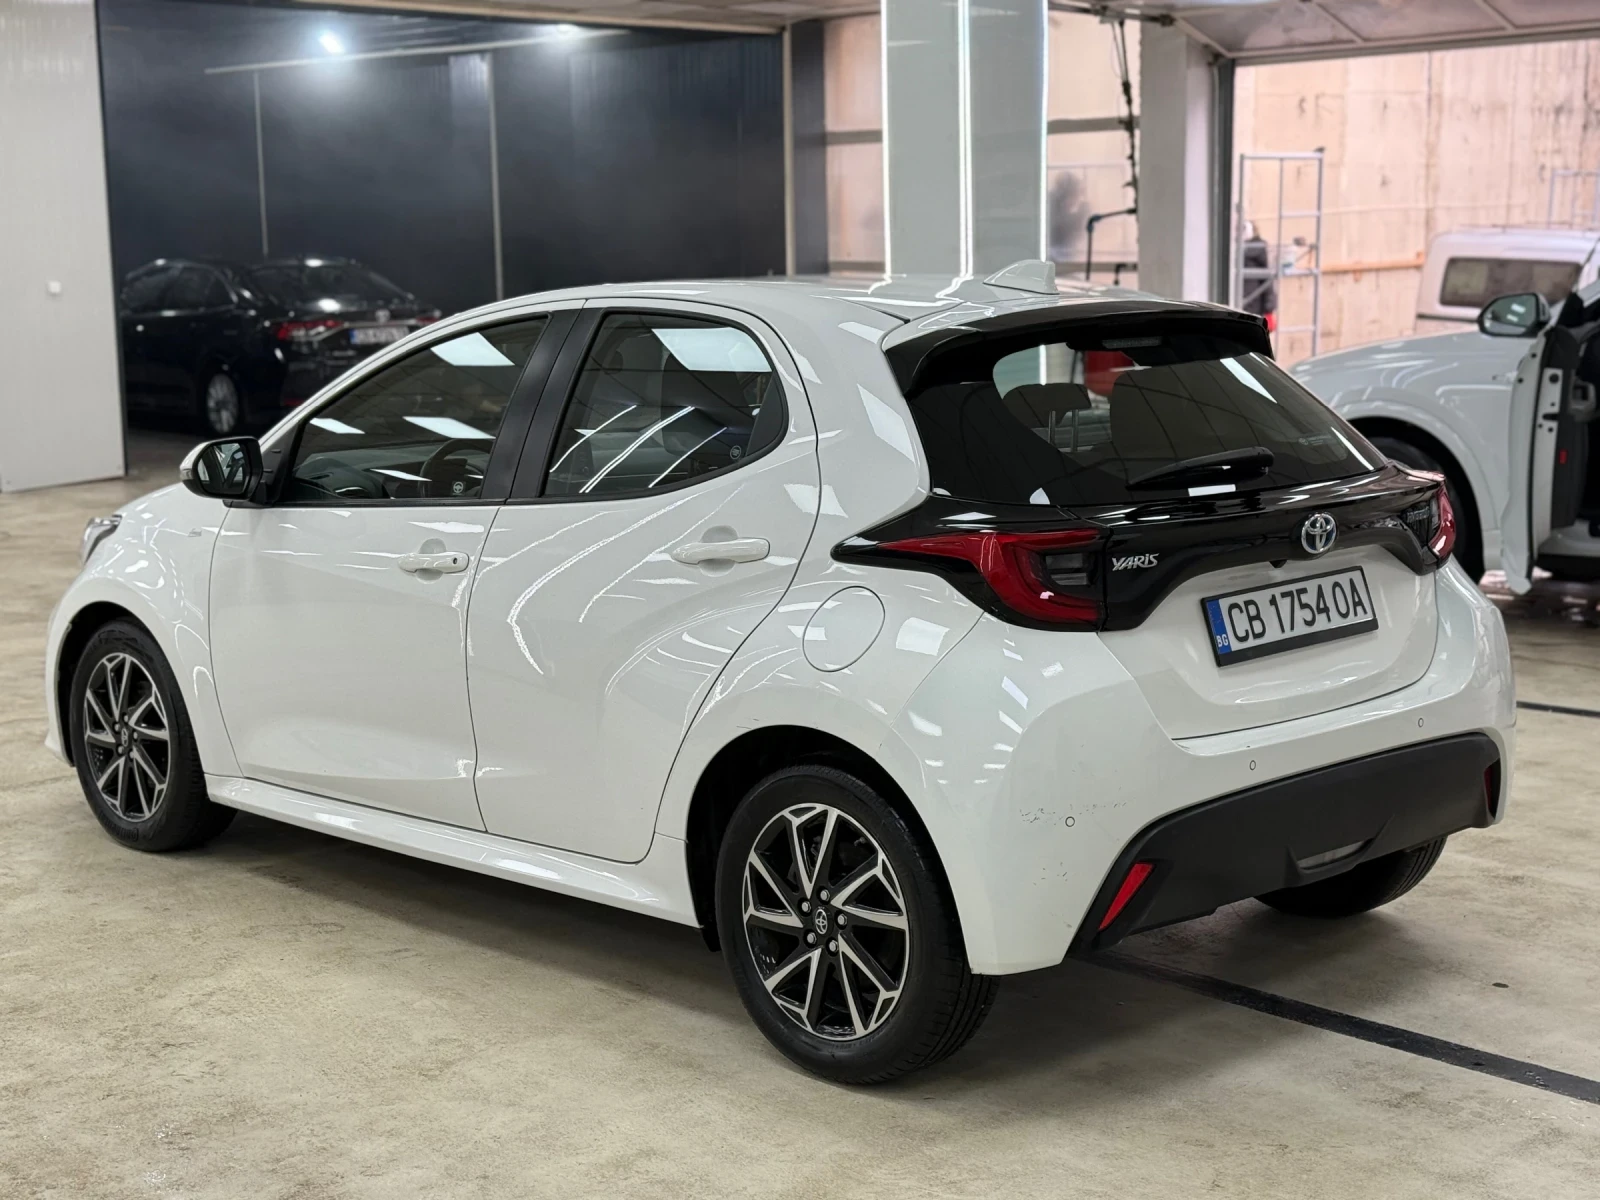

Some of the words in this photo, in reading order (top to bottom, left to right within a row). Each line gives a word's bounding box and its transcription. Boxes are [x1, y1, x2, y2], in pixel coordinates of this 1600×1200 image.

[1112, 553, 1160, 571] YARIS
[1227, 599, 1267, 643] CB
[1216, 633, 1229, 648] BG
